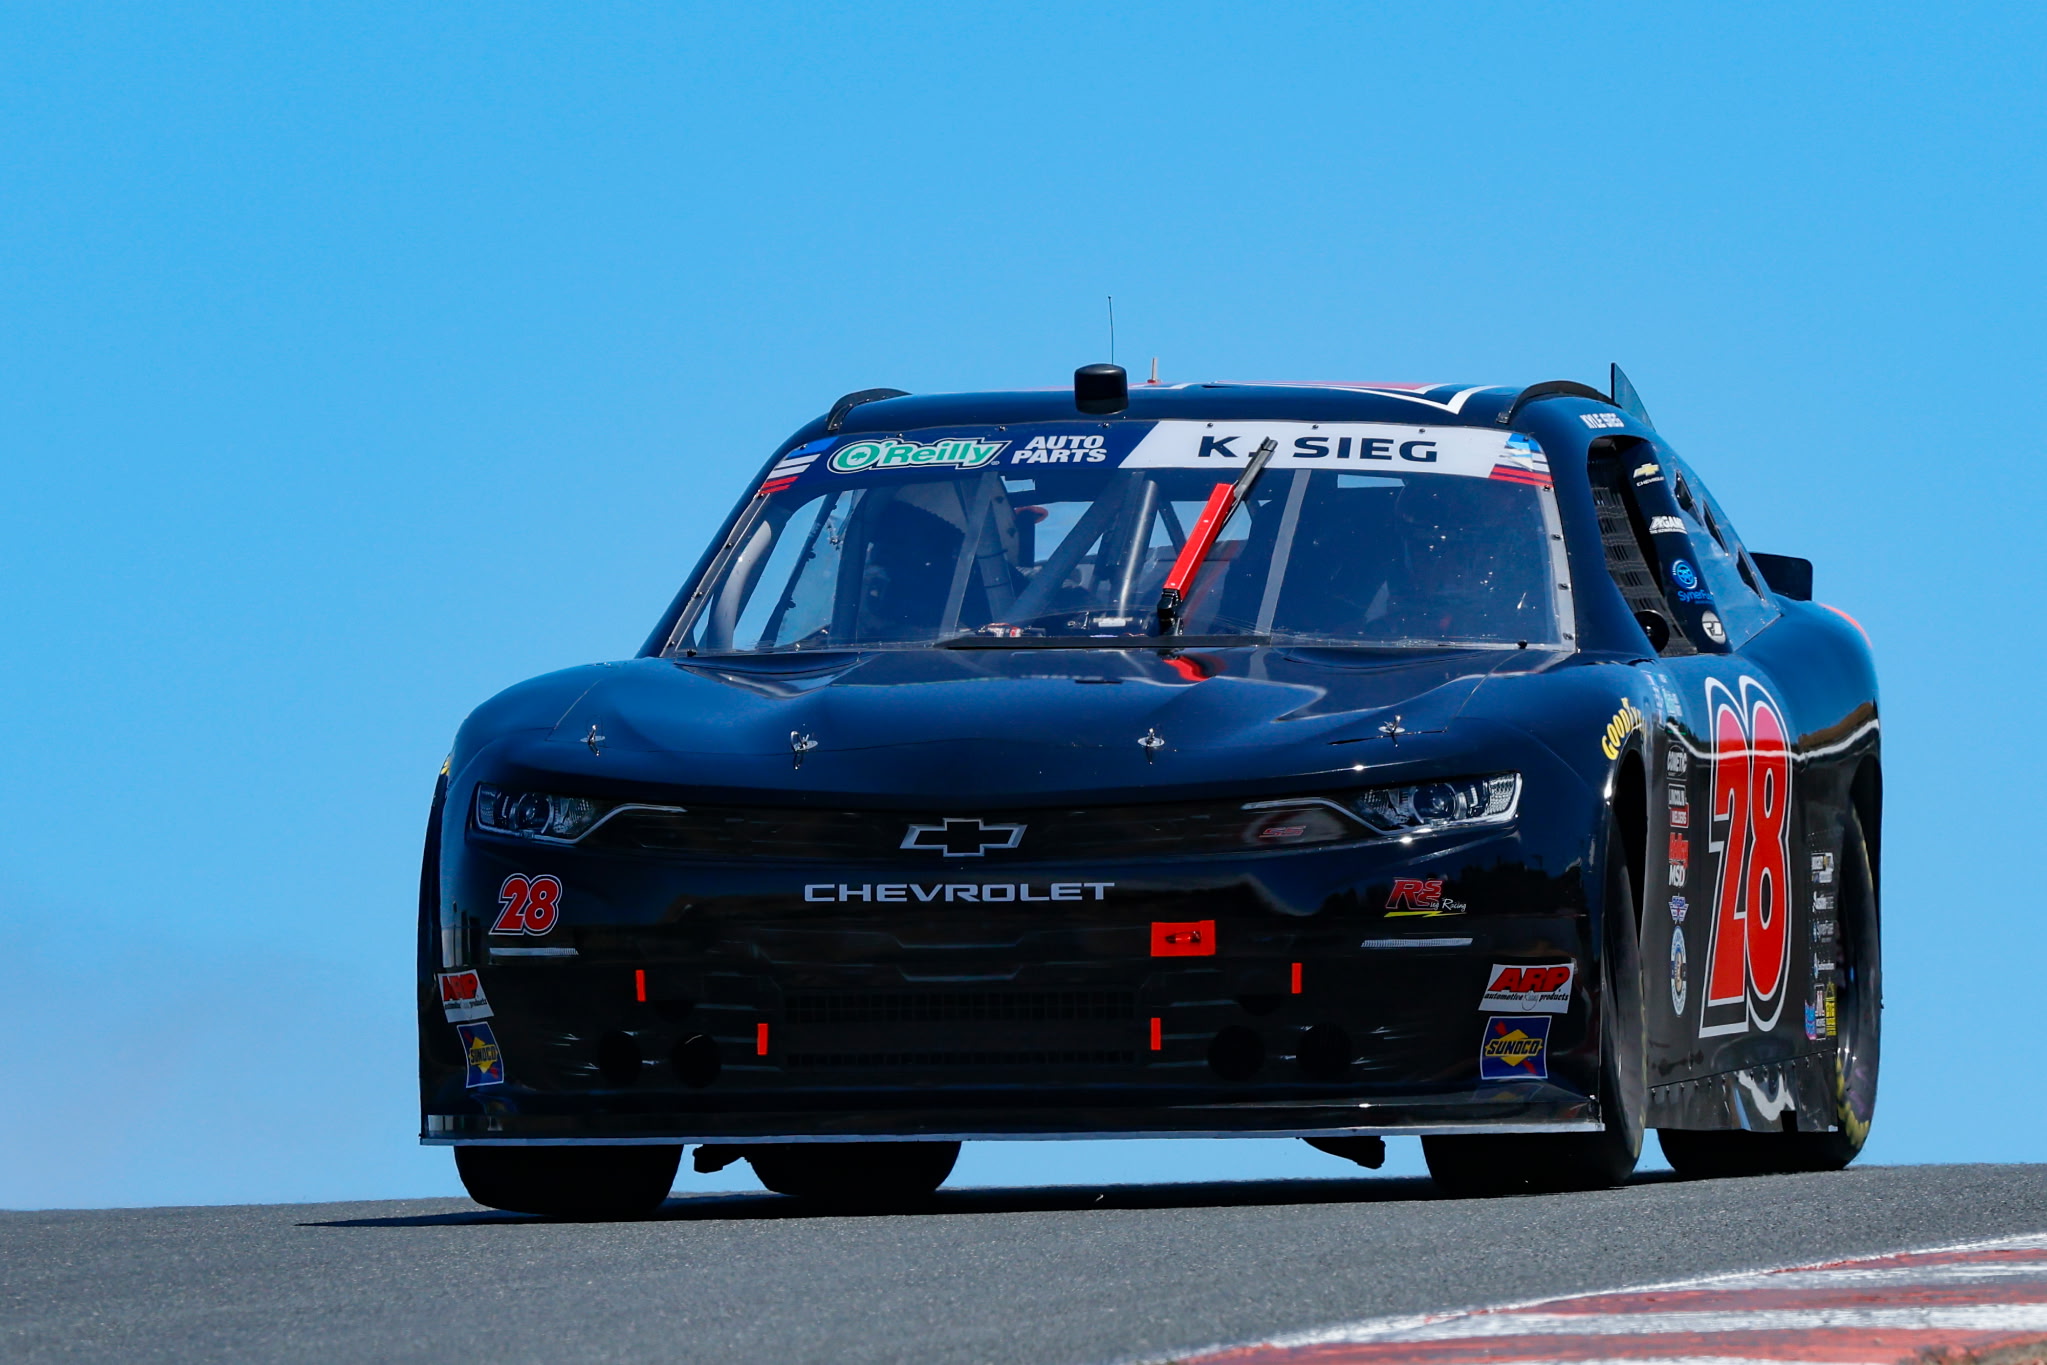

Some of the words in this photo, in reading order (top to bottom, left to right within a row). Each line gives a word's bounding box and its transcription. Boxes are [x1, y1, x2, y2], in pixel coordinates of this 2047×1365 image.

[831, 439, 1006, 470] O'Reilly
[1024, 434, 1105, 450] AUTO
[1292, 436, 1438, 464] SIEG
[1010, 448, 1108, 465] PARTS
[1698, 675, 1793, 1039] 28
[489, 872, 563, 937] 28
[804, 882, 1116, 903] CHEVROLET
[1488, 966, 1571, 993] ARP
[1486, 1039, 1540, 1055] SUNOCO
